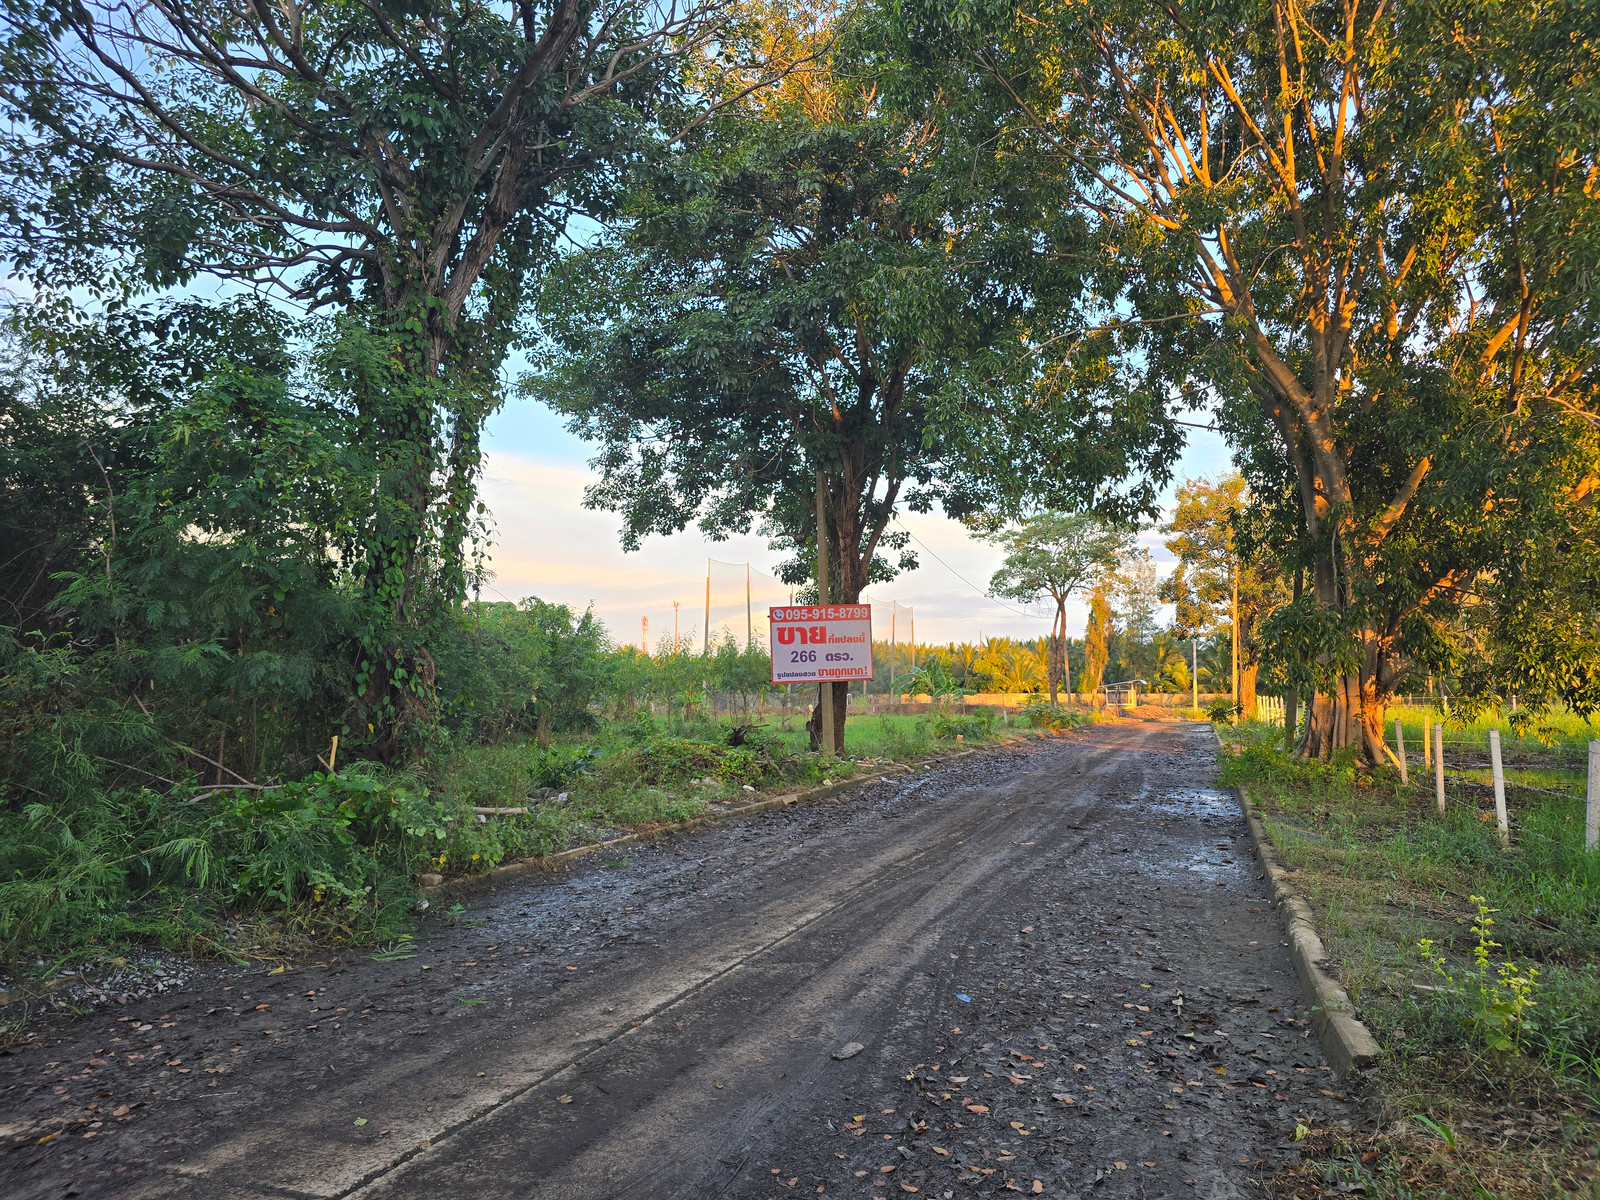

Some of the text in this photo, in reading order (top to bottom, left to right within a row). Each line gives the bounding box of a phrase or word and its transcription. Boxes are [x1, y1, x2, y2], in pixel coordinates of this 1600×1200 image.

[785, 607, 868, 620] 095-915-8799
[776, 626, 866, 645] ขาย ที่แปลงนี้
[790, 650, 854, 663] 266 ตรว.
[817, 666, 868, 678] ขายถูกมาก!
